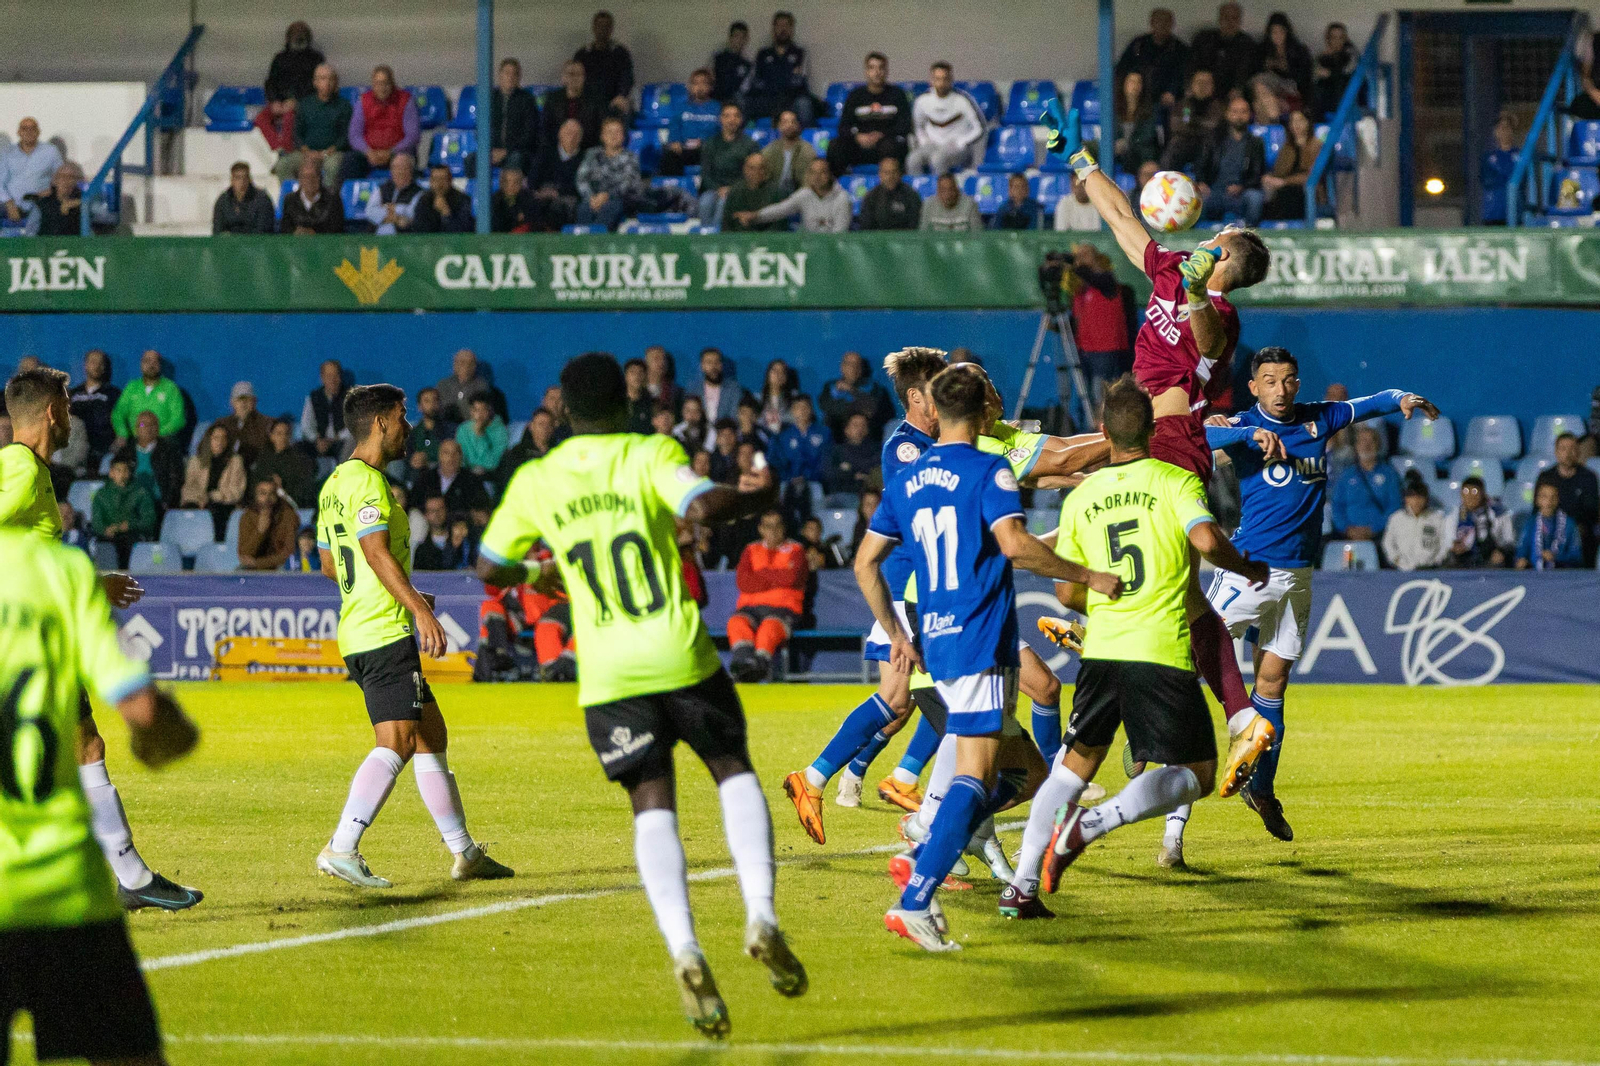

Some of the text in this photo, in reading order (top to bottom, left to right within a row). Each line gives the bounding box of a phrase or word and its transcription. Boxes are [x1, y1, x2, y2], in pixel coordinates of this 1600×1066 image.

[8, 250, 106, 293] JAÉN
[434, 247, 808, 290] CAJA RURAL JAÉN
[1265, 241, 1529, 284] RURAL JAÉN
[905, 467, 961, 498] ALFONSO
[553, 492, 636, 532] A.KOROMA
[911, 505, 959, 592] 11
[1104, 517, 1146, 597] 5
[566, 530, 667, 627] 10
[1220, 586, 1242, 611] 7
[177, 606, 340, 658] TECNOCA
